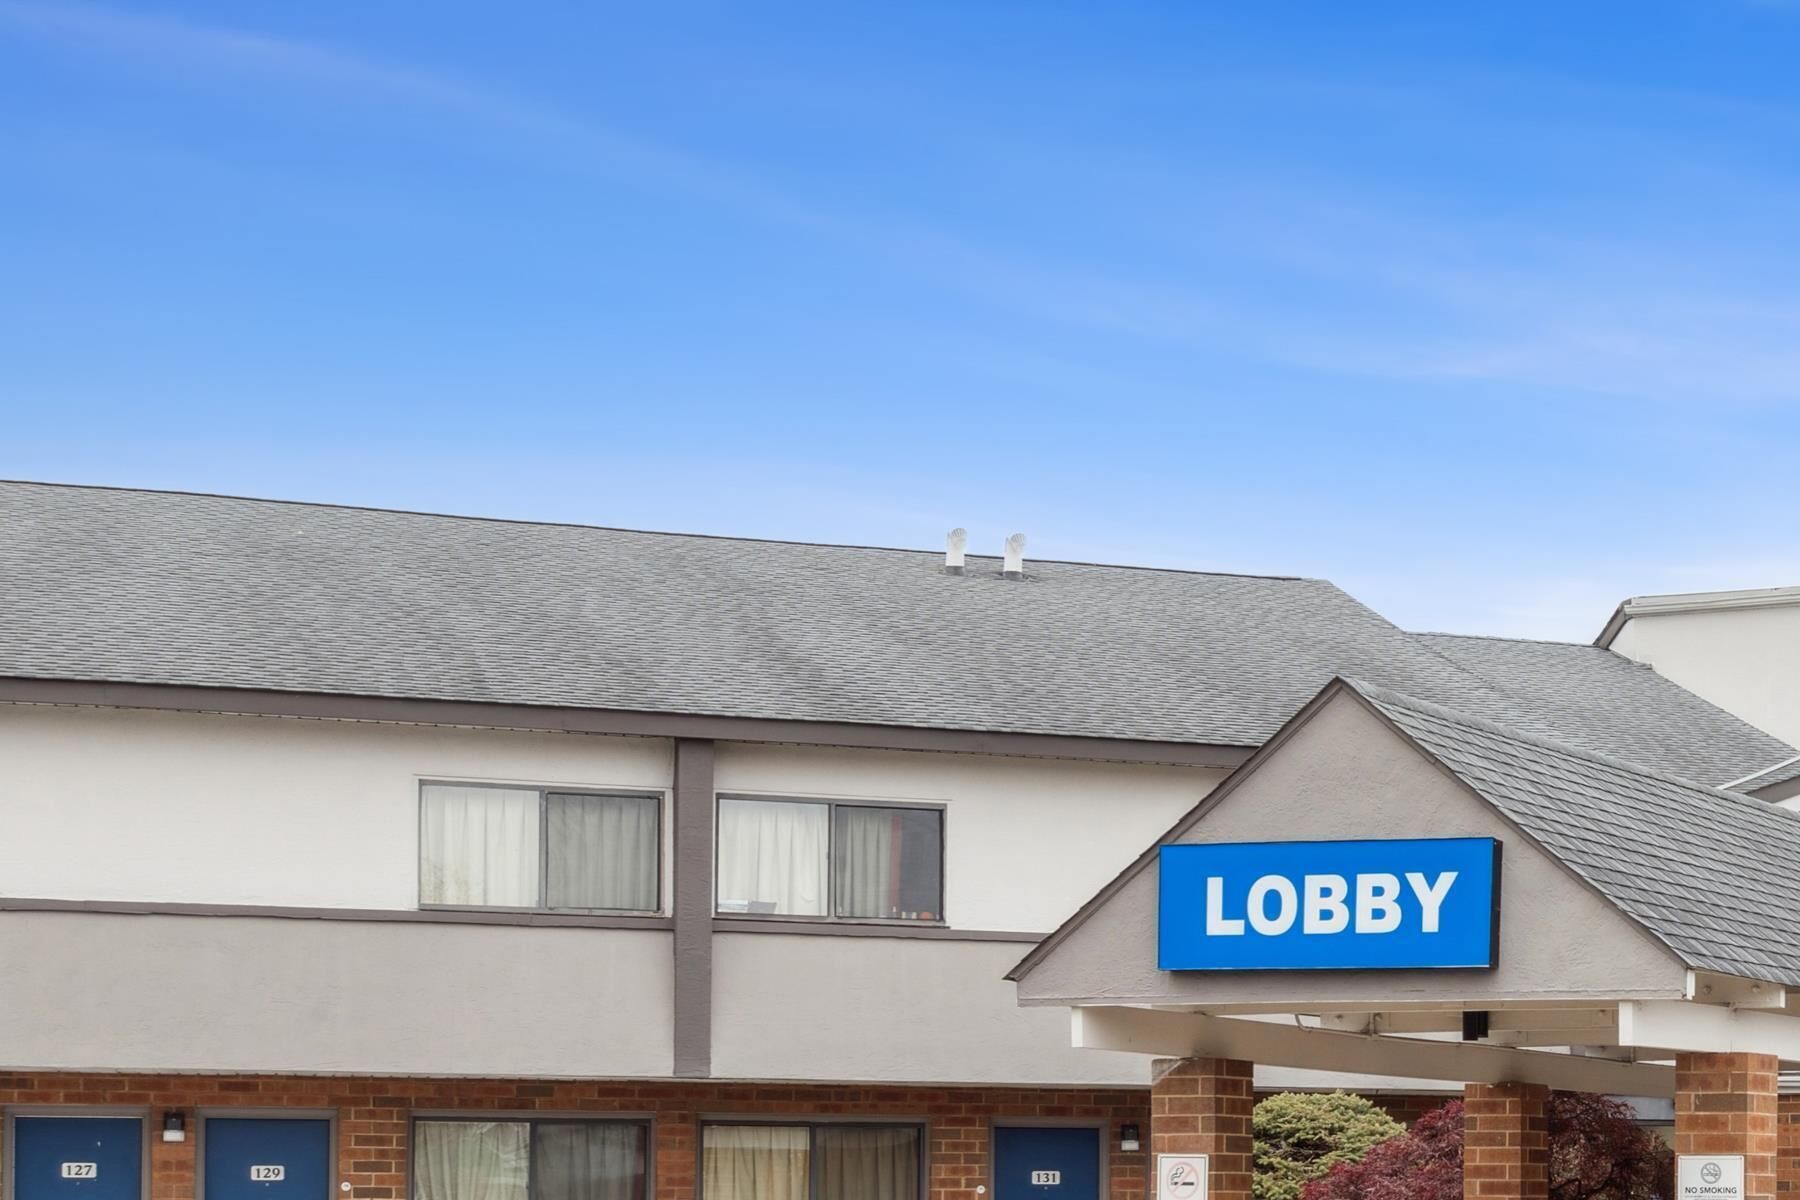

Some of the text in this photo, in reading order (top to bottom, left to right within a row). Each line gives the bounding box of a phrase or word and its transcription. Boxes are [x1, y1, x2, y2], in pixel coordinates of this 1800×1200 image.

[1206, 871, 1459, 936] LOBBY
[66, 1165, 92, 1176] 127
[255, 1168, 281, 1179] 129
[1036, 1172, 1056, 1183] 131
